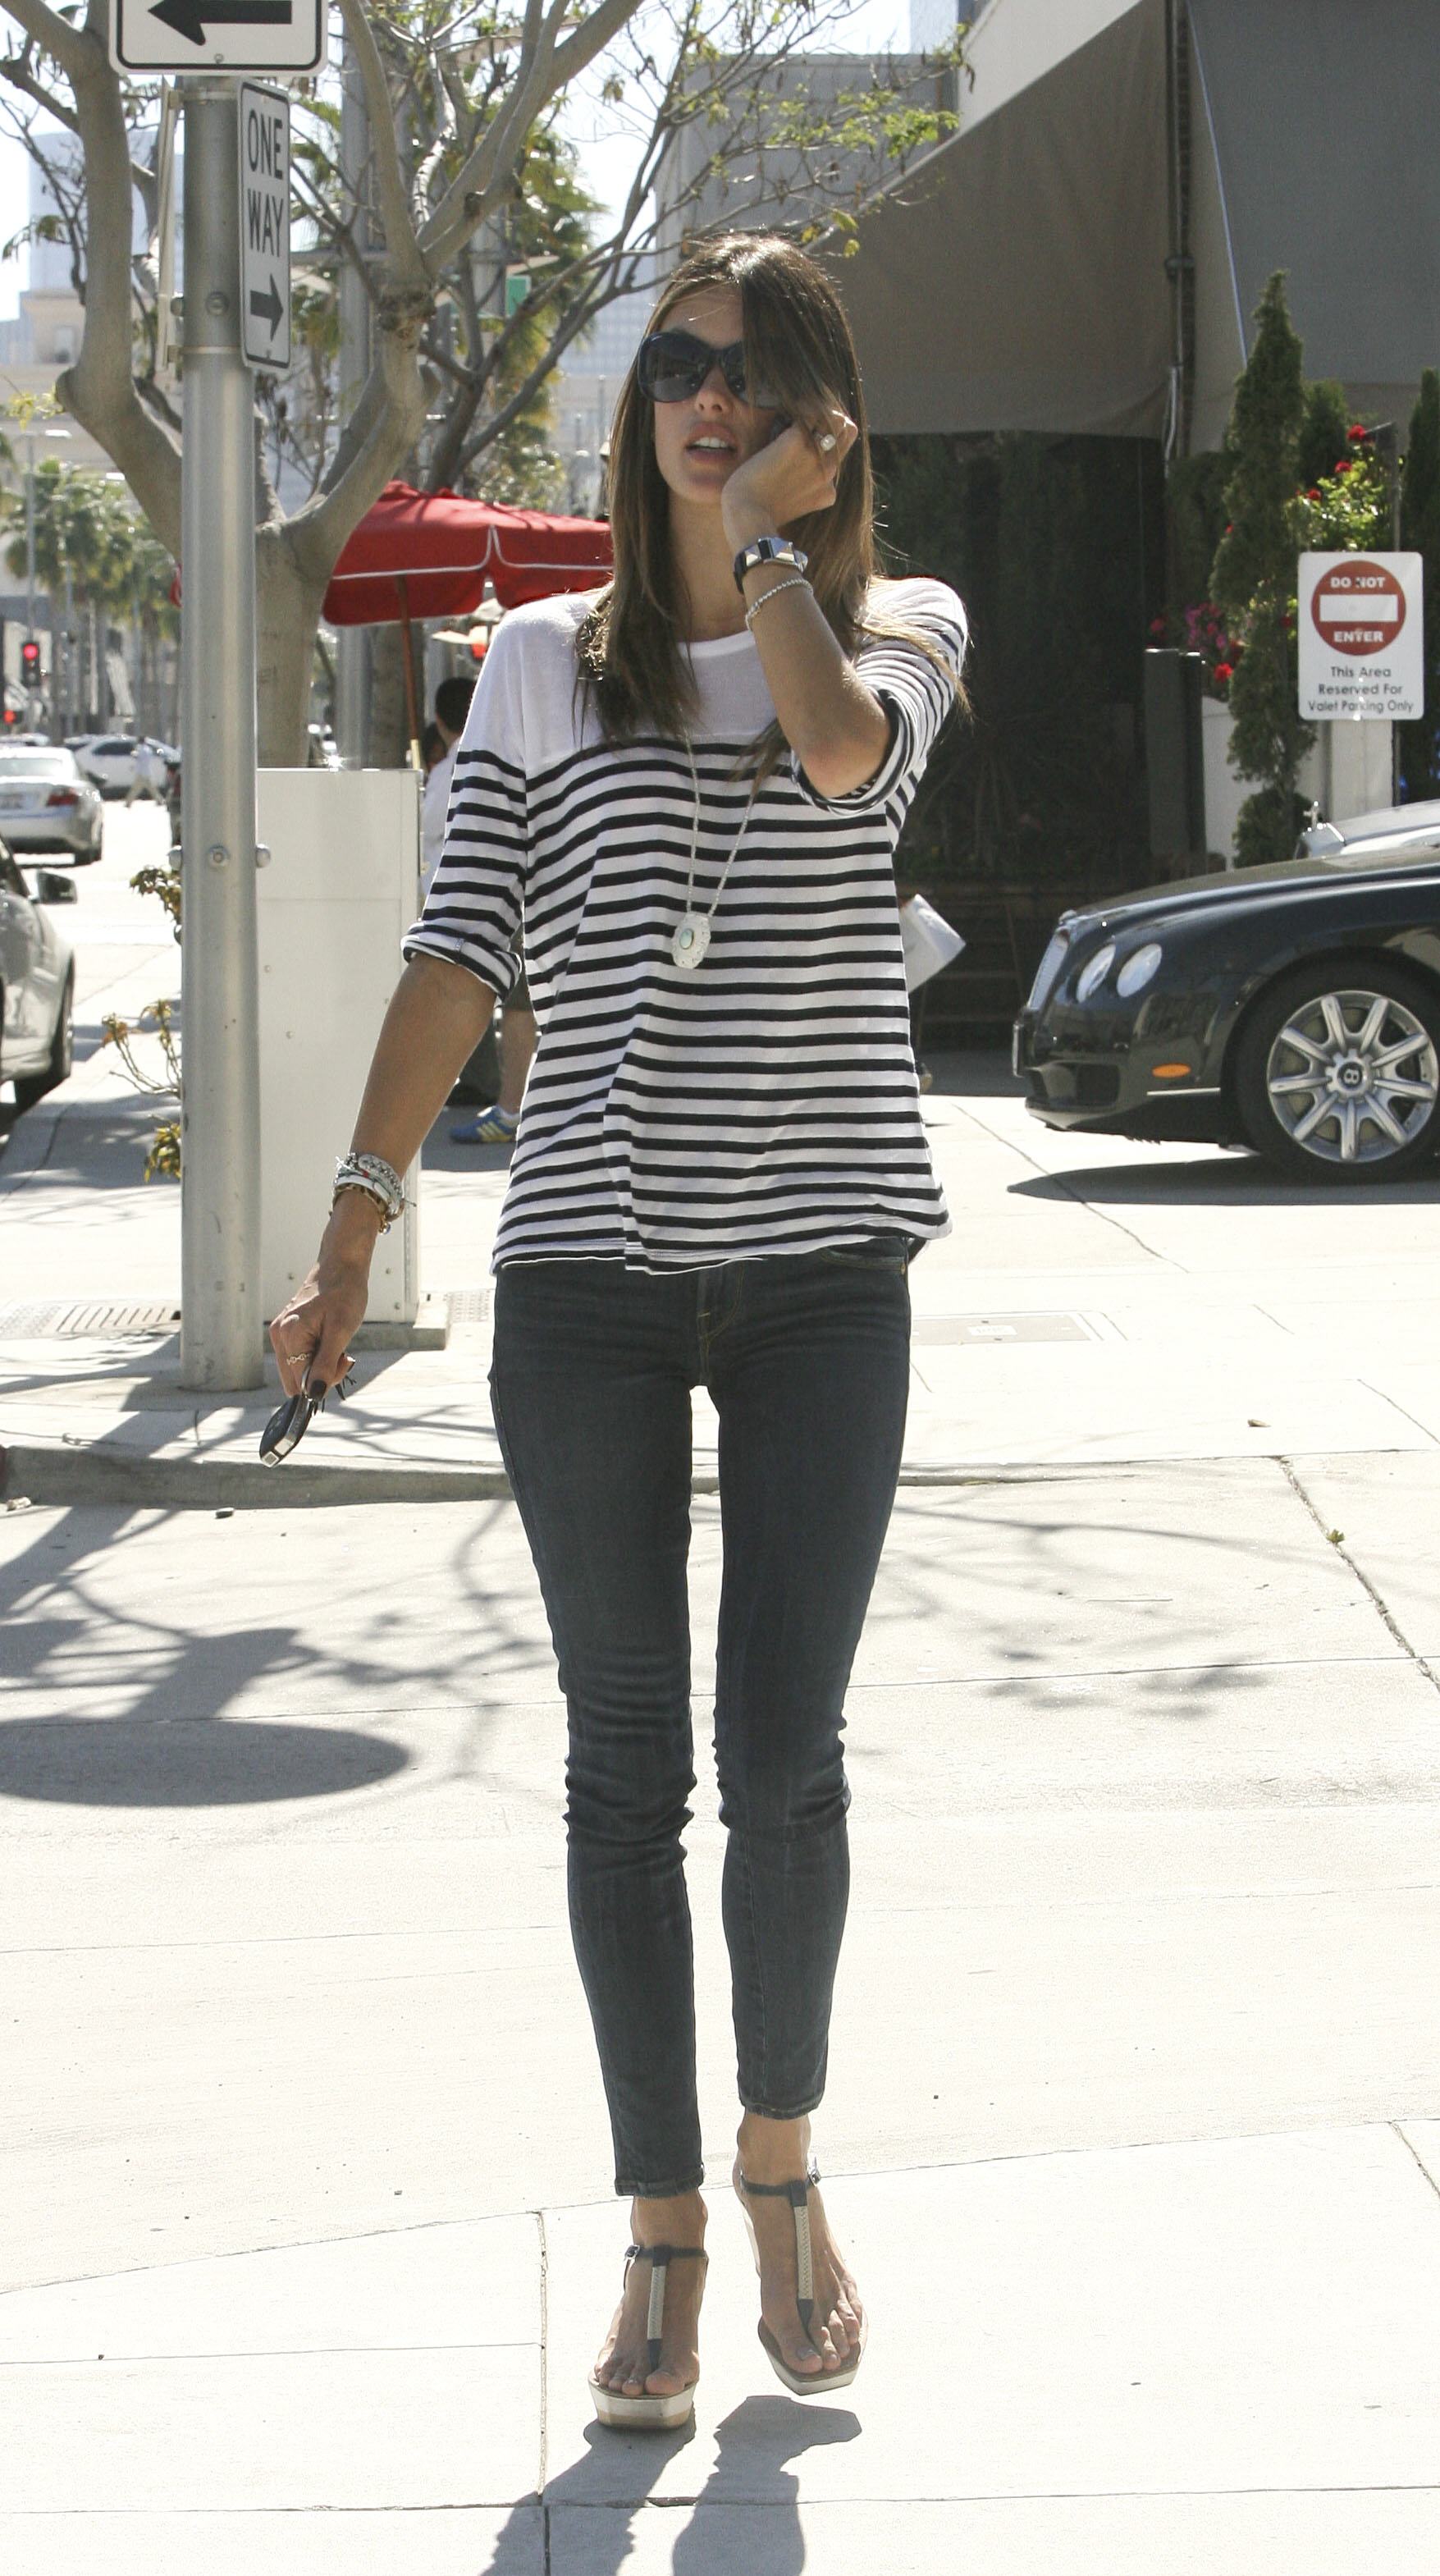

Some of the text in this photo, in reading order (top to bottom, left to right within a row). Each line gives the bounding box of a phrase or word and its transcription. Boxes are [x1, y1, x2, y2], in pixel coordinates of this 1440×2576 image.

[248, 109, 283, 180] ONE
[248, 190, 284, 257] WAY
[1331, 577, 1386, 588] DO NOT
[1333, 630, 1384, 643] ENTER
[1331, 666, 1392, 678] This Area
[1319, 684, 1403, 695] Reserved For
[1308, 700, 1337, 711] Valet
[1387, 699, 1414, 713] Only
